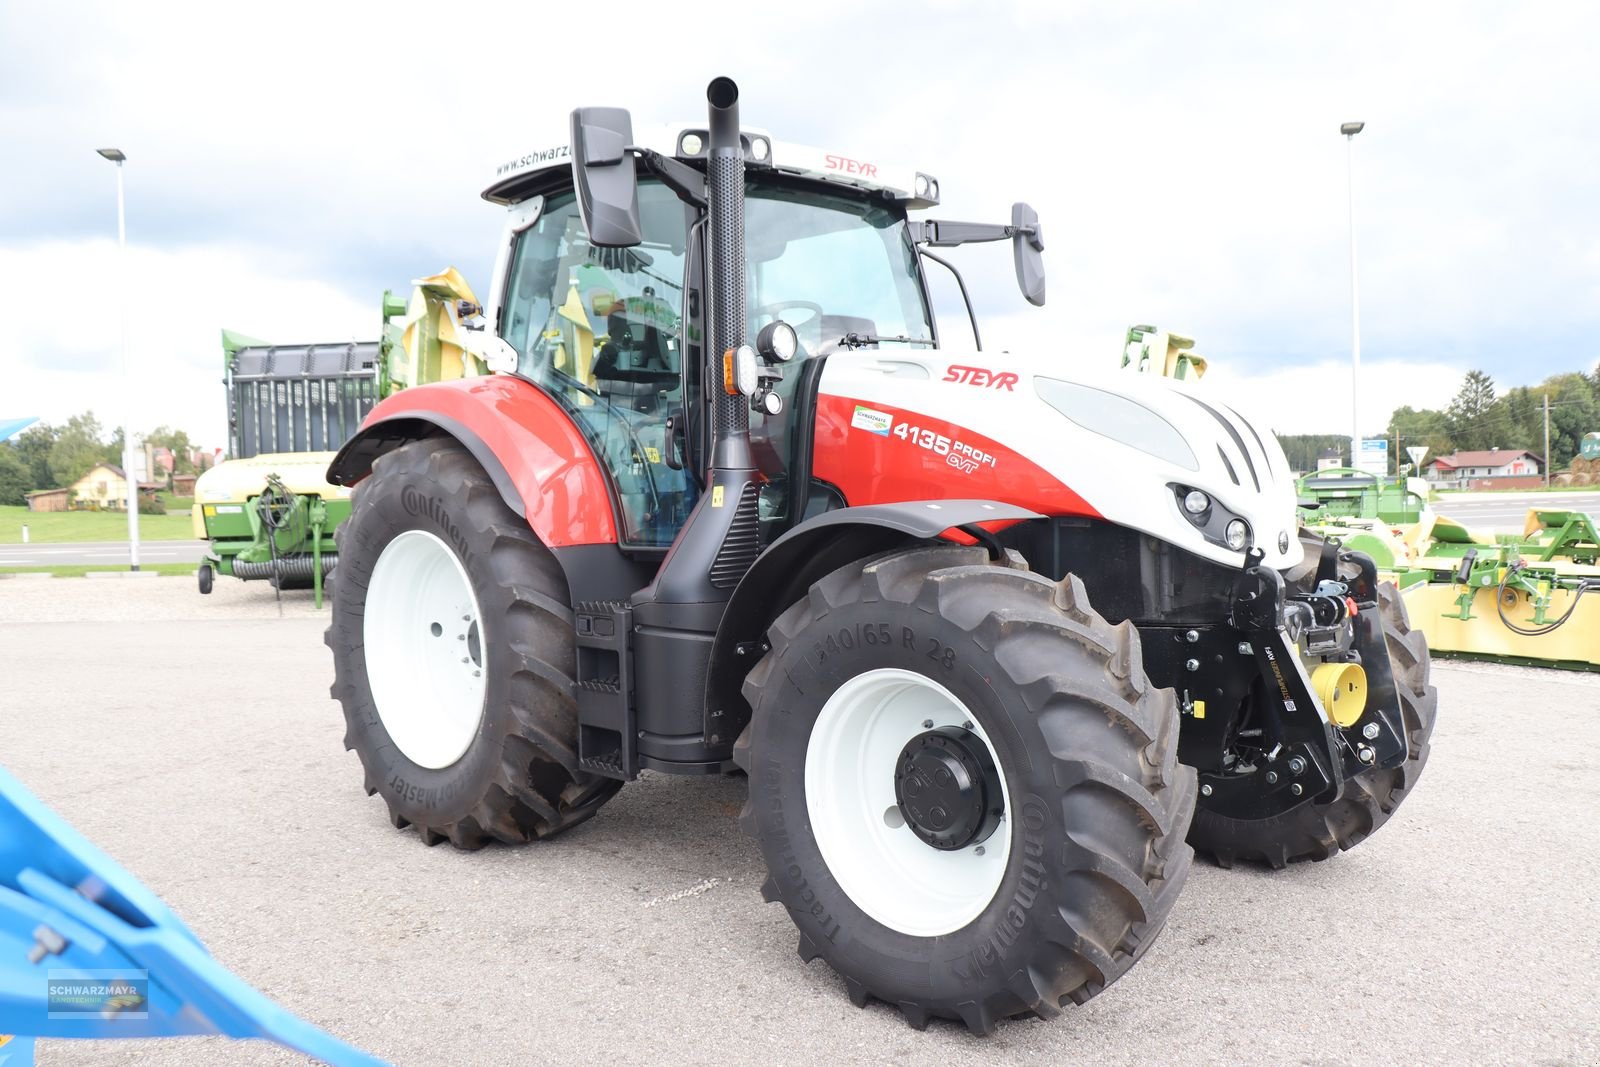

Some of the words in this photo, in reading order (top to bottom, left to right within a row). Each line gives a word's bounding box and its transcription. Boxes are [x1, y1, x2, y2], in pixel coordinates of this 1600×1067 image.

[496, 144, 572, 176] www.schwarz
[824, 154, 878, 178] STEYR
[942, 364, 1019, 392] STEYR
[893, 422, 952, 456] 4135
[952, 441, 997, 468] PROFI
[946, 453, 979, 474] CVT
[401, 484, 474, 569] Continent
[902, 625, 916, 652] R
[926, 637, 957, 670] 28
[973, 792, 1051, 977] Continental
